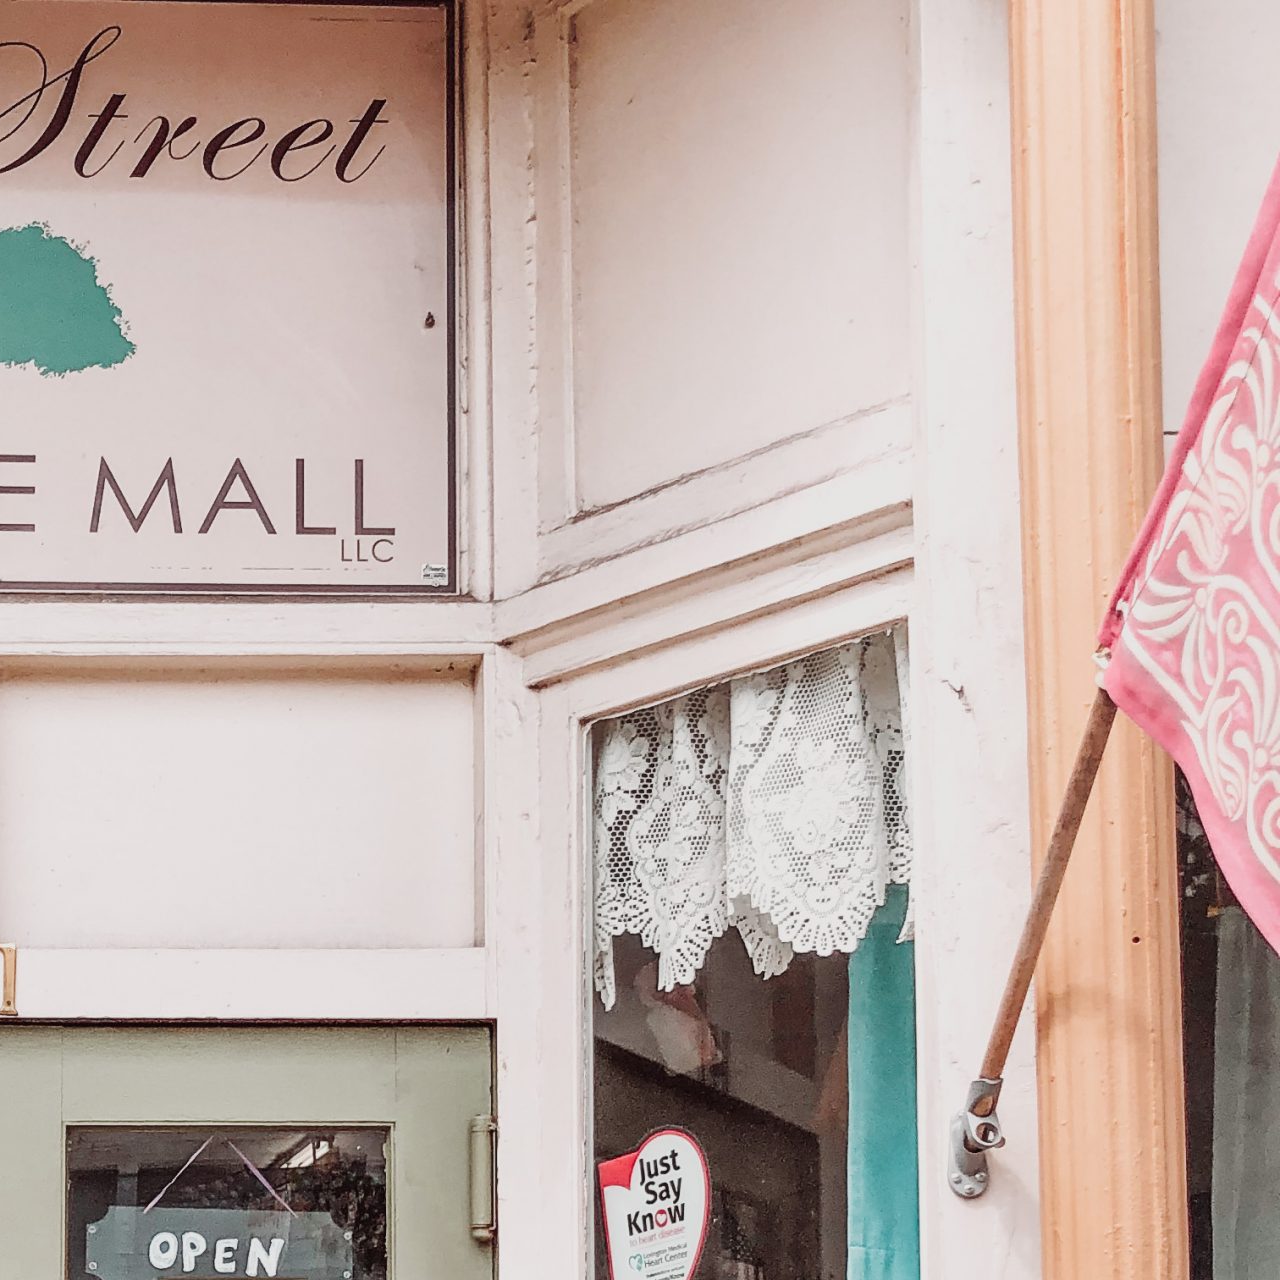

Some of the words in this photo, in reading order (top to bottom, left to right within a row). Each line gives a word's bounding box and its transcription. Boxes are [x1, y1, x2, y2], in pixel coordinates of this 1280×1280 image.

[90, 455, 396, 536] MALL
[339, 538, 395, 564] LLC
[639, 1149, 680, 1186] Just
[644, 1177, 682, 1205] Say
[627, 1203, 685, 1236] Know
[149, 1231, 285, 1277] OPEN
[644, 1258, 663, 1268] Heart
[665, 1251, 687, 1262] Center
